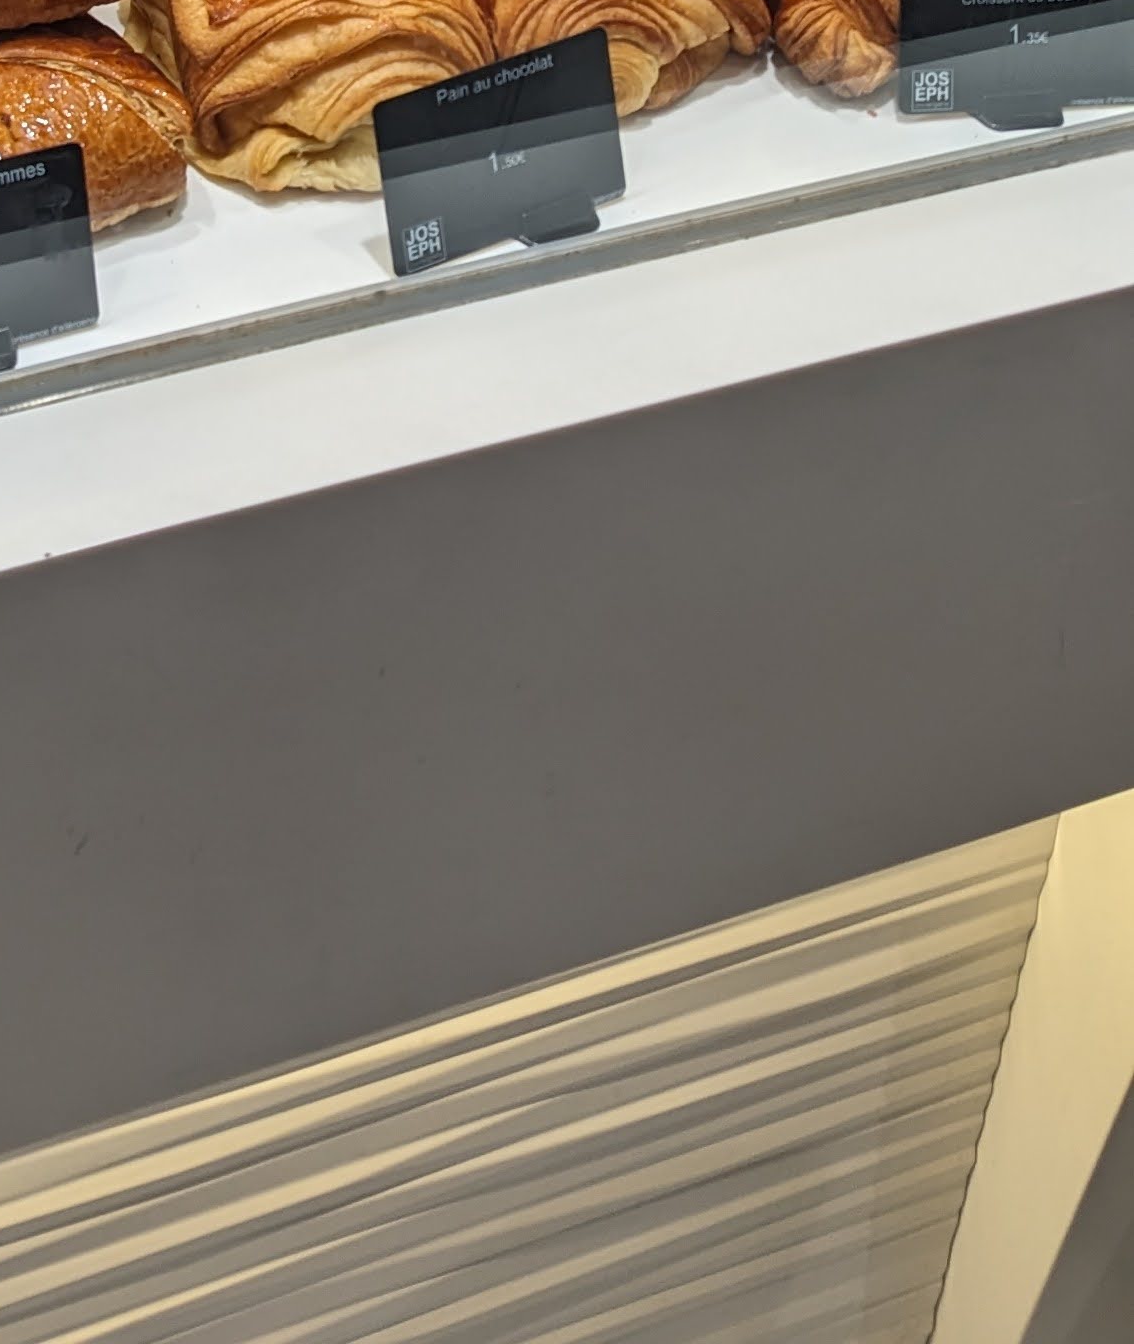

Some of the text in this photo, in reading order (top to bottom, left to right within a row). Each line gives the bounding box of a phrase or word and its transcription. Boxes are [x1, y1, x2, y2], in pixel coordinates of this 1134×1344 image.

[436, 53, 554, 105] Pain au chocolat
[914, 71, 949, 87] JOS
[914, 86, 949, 102] EPH
[406, 221, 439, 246] JOS
[408, 238, 441, 262] EPH
